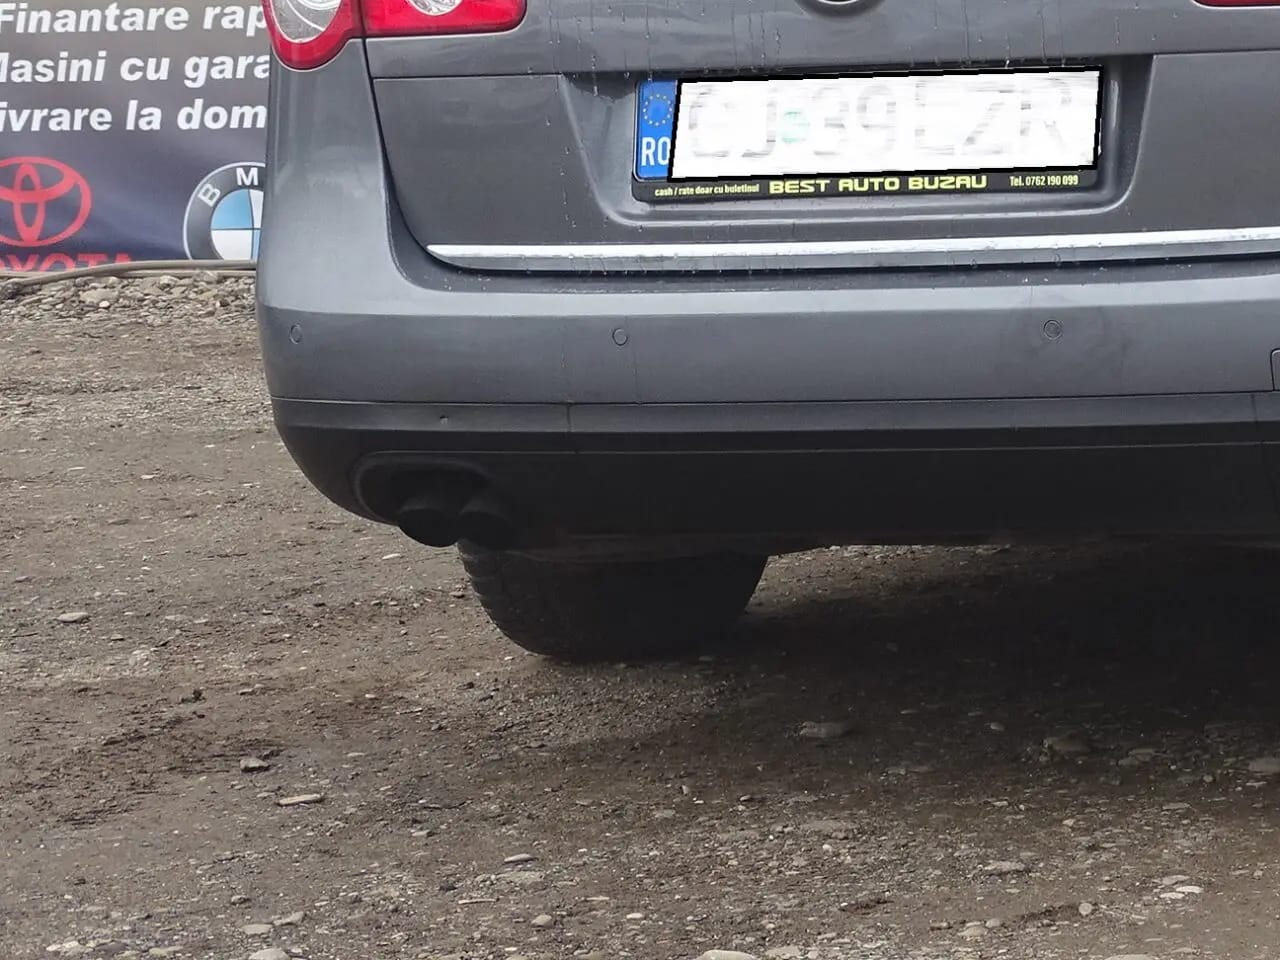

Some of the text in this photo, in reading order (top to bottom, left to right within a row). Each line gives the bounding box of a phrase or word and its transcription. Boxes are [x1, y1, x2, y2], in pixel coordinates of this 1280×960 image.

[0, 51, 270, 88] asini cu gara
[126, 99, 163, 131] la
[177, 98, 268, 130] dom
[641, 136, 671, 166] RO
[654, 187, 673, 197] cash
[678, 187, 695, 197] rate
[695, 185, 714, 196] doar
[714, 186, 724, 194] cu
[724, 184, 760, 194] buletinul
[769, 179, 830, 194] BEST
[838, 177, 900, 192] AUTO
[908, 175, 987, 190] BUZAU
[1009, 176, 1025, 187] Tel.
[1025, 176, 1046, 187] 0762
[1046, 175, 1061, 186] 190
[1062, 175, 1079, 186] 099
